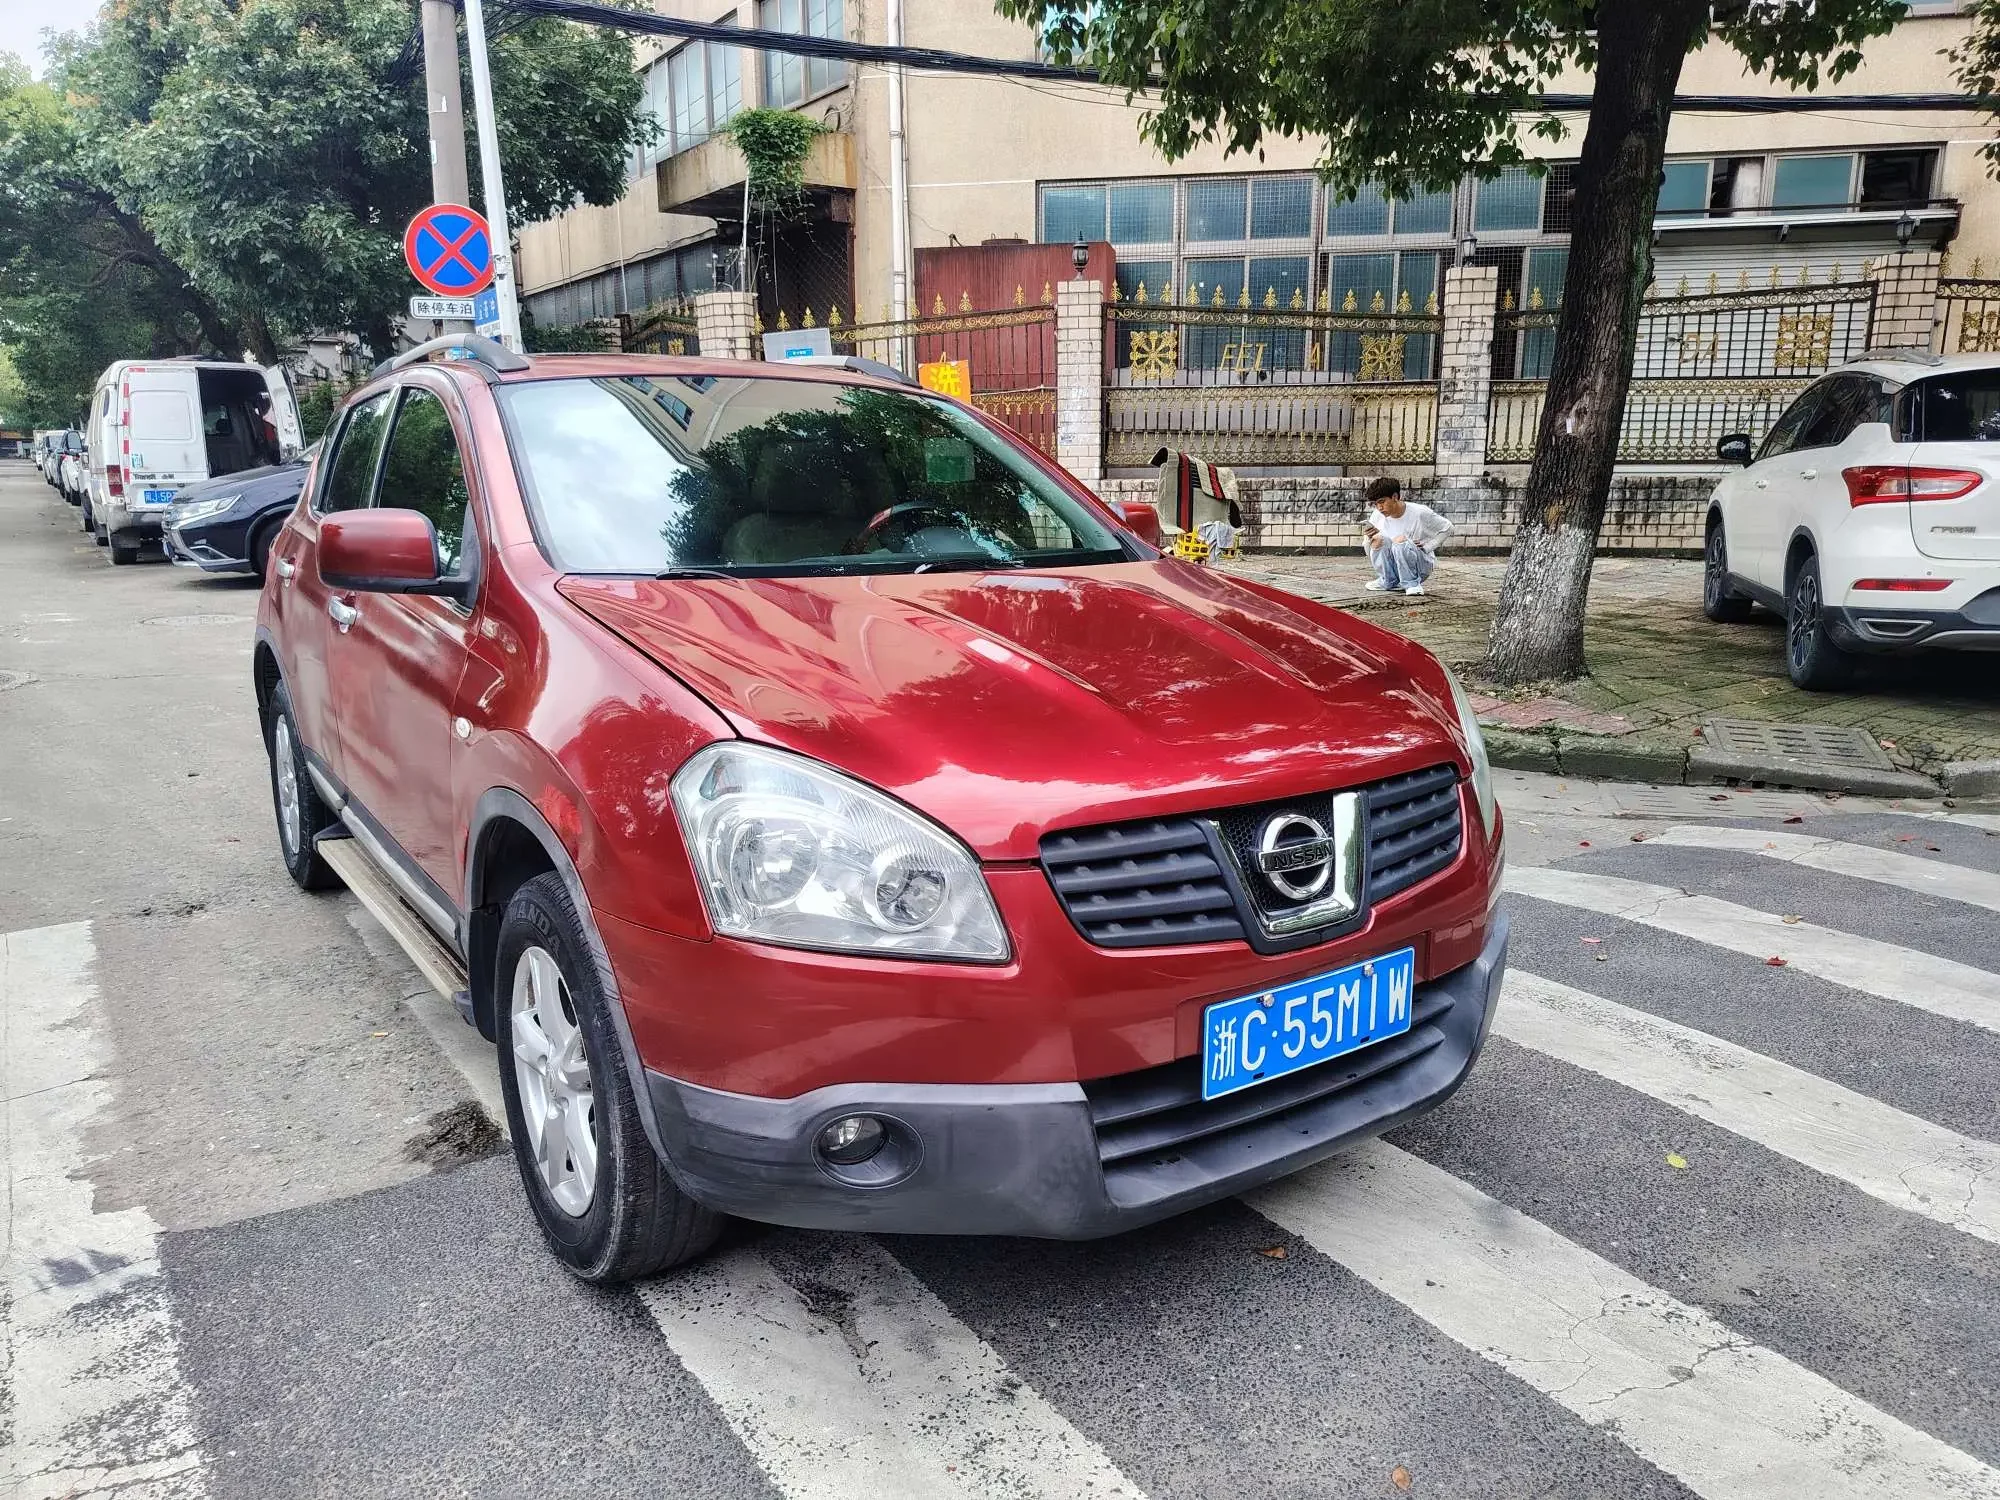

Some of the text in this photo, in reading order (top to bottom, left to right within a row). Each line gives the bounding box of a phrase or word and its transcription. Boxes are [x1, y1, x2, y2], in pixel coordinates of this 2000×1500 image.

[417, 302, 473, 315] 除停车泊
[929, 363, 962, 397] 洗
[1273, 841, 1334, 868] NISSAN
